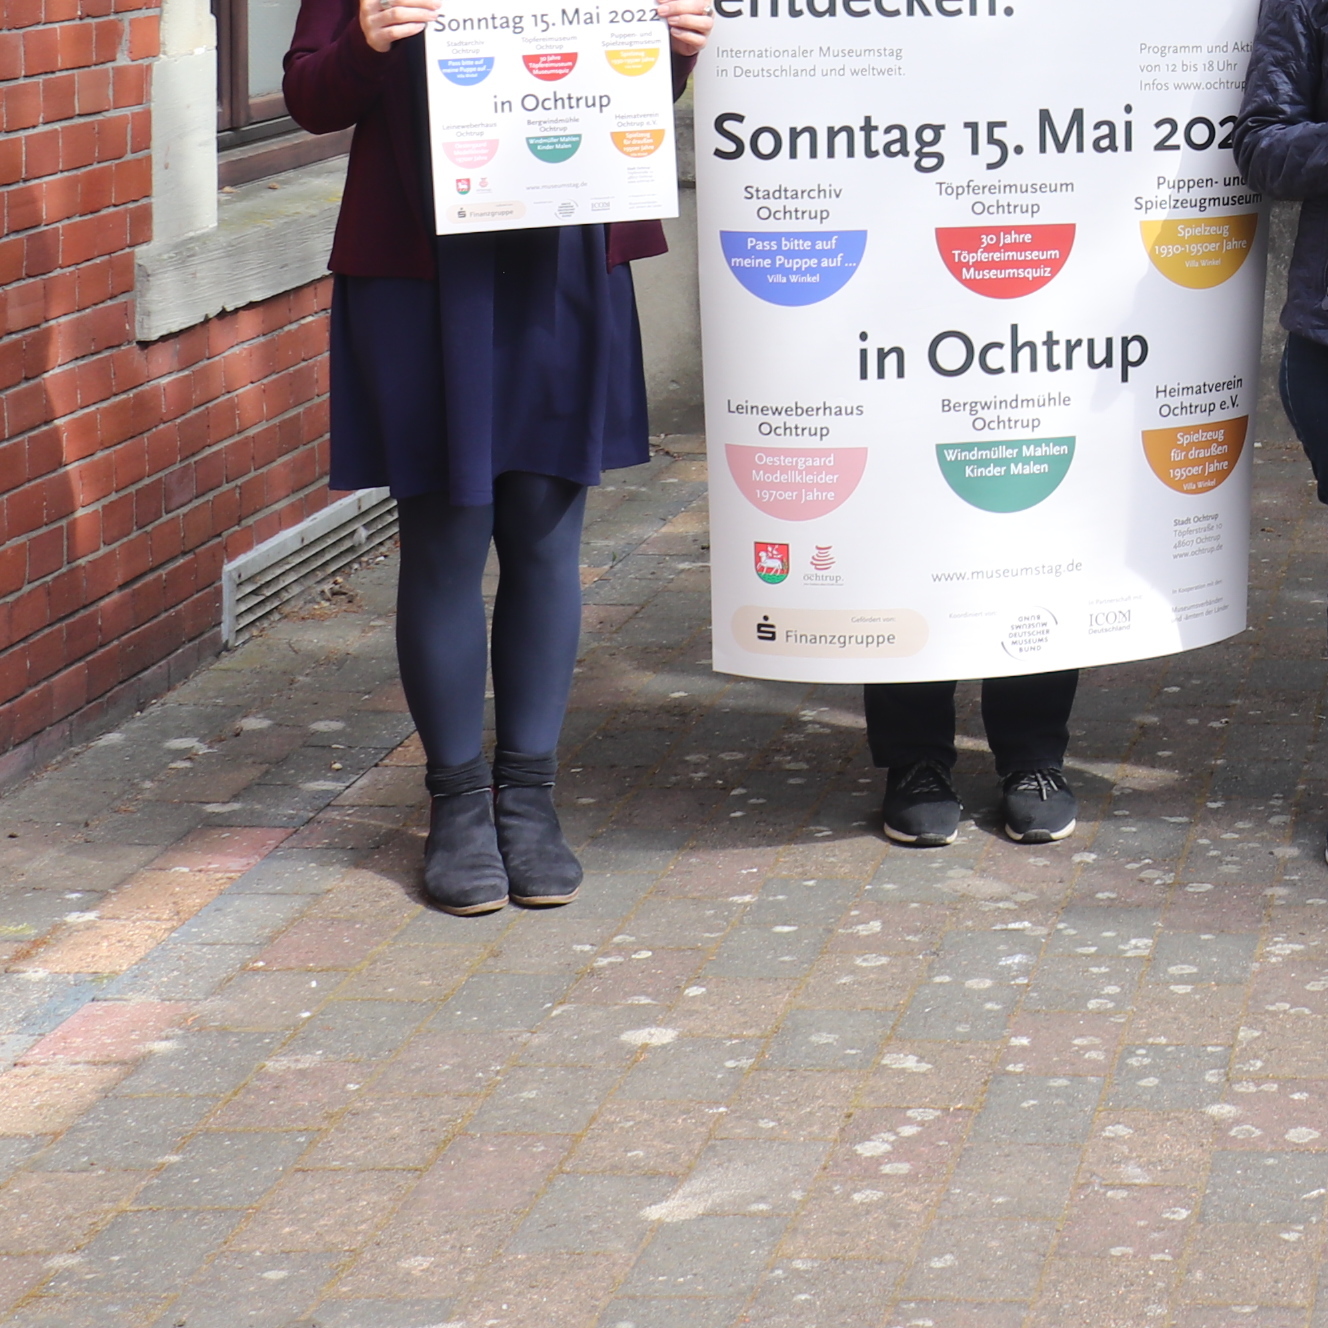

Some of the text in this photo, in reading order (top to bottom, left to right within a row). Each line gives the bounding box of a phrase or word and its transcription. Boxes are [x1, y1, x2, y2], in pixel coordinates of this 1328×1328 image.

[432, 6, 662, 34] Sonntag 15. Mai 2022
[717, 46, 902, 60] Internationaler Museumstag
[1140, 41, 1252, 57] Programm und Akti
[717, 64, 906, 77] in Deutschland und weltweit.
[1139, 60, 1237, 72] von 12 bis 18 Uhr
[1140, 78, 1246, 92] Infos www.ochtrup
[494, 91, 610, 113] in Ochtrup
[713, 104, 1235, 173] Sonntag 15. Mai 202
[744, 184, 842, 200] Stadtarchiv
[936, 180, 1074, 200] Töpfereimuseum
[1157, 176, 1218, 192] Puppen-
[971, 200, 1040, 218] Ochtrup
[1134, 192, 1262, 214] Spielzeugmuseum
[757, 205, 829, 224] Ochtrup
[981, 231, 1032, 247] 30 Jahre
[1178, 224, 1229, 238] Spielzeug
[748, 235, 838, 250] Pass bitte auf
[1154, 237, 1247, 256] 1930-1950er Jahre
[730, 256, 771, 270] meine
[776, 256, 818, 271] Puppe
[952, 249, 1059, 265] Töpfereimuseum
[1185, 258, 1221, 268] Villa Winkel
[767, 274, 819, 283] Villa Winkel
[962, 267, 1051, 280] Museumsquiz
[859, 324, 1148, 383] in Ochtrup
[1156, 376, 1243, 399] Heimatverein
[727, 399, 863, 416] Leineweberhaus
[942, 392, 1070, 416] Bergwindmühle
[1159, 395, 1239, 418] Ochtrup e.V.
[758, 422, 829, 441] Ochtrup
[972, 415, 1040, 432] Ochtrup
[1177, 428, 1224, 444] Spielzeug
[944, 443, 1067, 461] Windmüller Mahlen
[1171, 444, 1228, 462] für draußen
[753, 451, 834, 470] Oestergaard
[750, 468, 839, 486] Modellkleider
[966, 461, 1048, 477] Kinder Malen
[1169, 460, 1228, 480] 1950er Jahre
[754, 488, 834, 504] 1970er Jahre
[1174, 513, 1218, 526] Stadt Ochtrup
[1174, 524, 1214, 538] Töpferstraße
[1196, 534, 1221, 544] Ochtrup
[1173, 544, 1223, 559] www.ochtrup.de
[931, 559, 1082, 582] www.museumstag.de
[1089, 610, 1131, 628] ICOM
[786, 630, 895, 648] Finanzgruppe
[1009, 629, 1050, 638] DEUTSCHER
